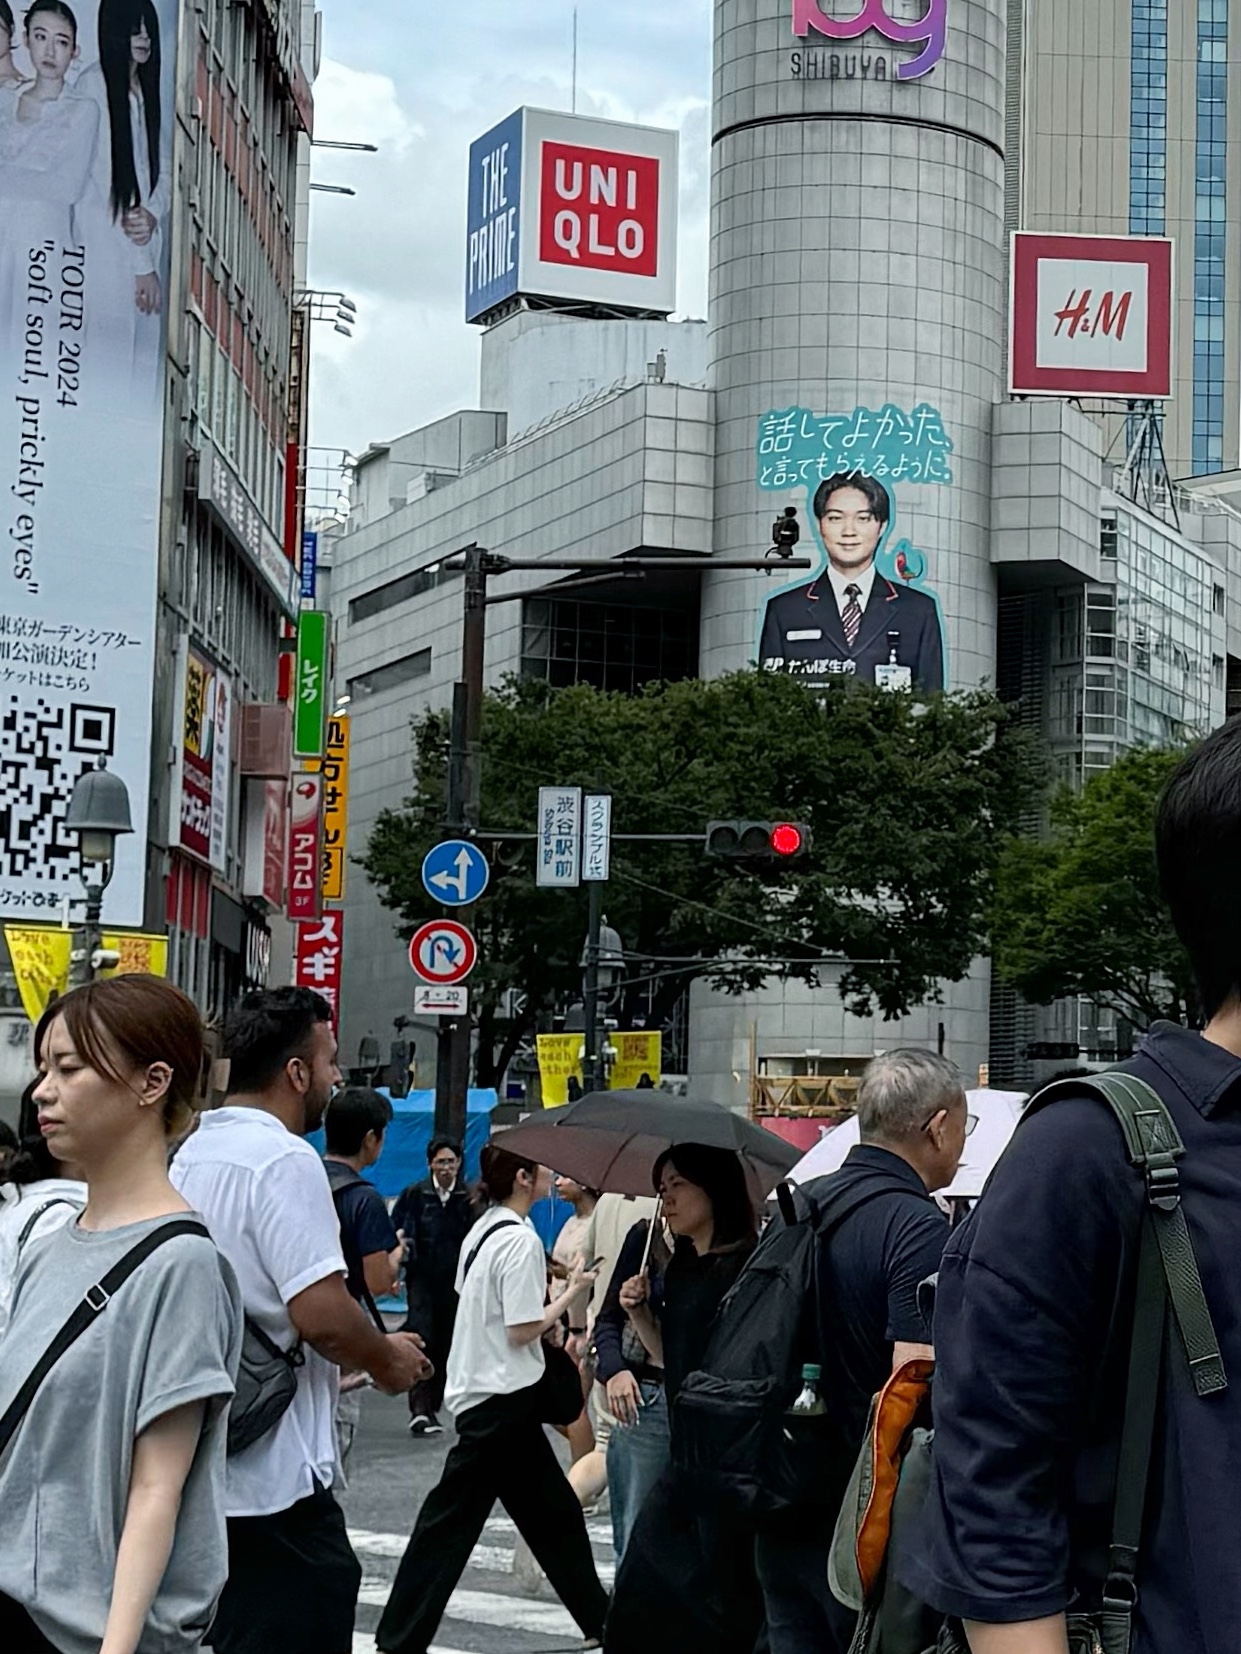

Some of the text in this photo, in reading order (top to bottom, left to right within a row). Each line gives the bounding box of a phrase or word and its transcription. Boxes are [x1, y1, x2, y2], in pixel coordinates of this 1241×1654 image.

[791, 52, 887, 80] SHIBUYA
[482, 142, 509, 219] THE
[555, 158, 637, 210] UNI
[469, 206, 516, 296] PRIME
[553, 209, 645, 259] QLO
[56, 245, 86, 408] TOUR 2024
[1054, 289, 1132, 341] H&M
[9, 240, 55, 595] "soft soul, prickly eyes"
[760, 408, 951, 454] 話してよかった、
[760, 450, 951, 486] と言ってもらえるように。
[0, 668, 89, 692] ケットはこちら
[301, 659, 319, 704] レイク
[294, 834, 314, 889] アコム
[556, 796, 575, 878] 渋谷駅前
